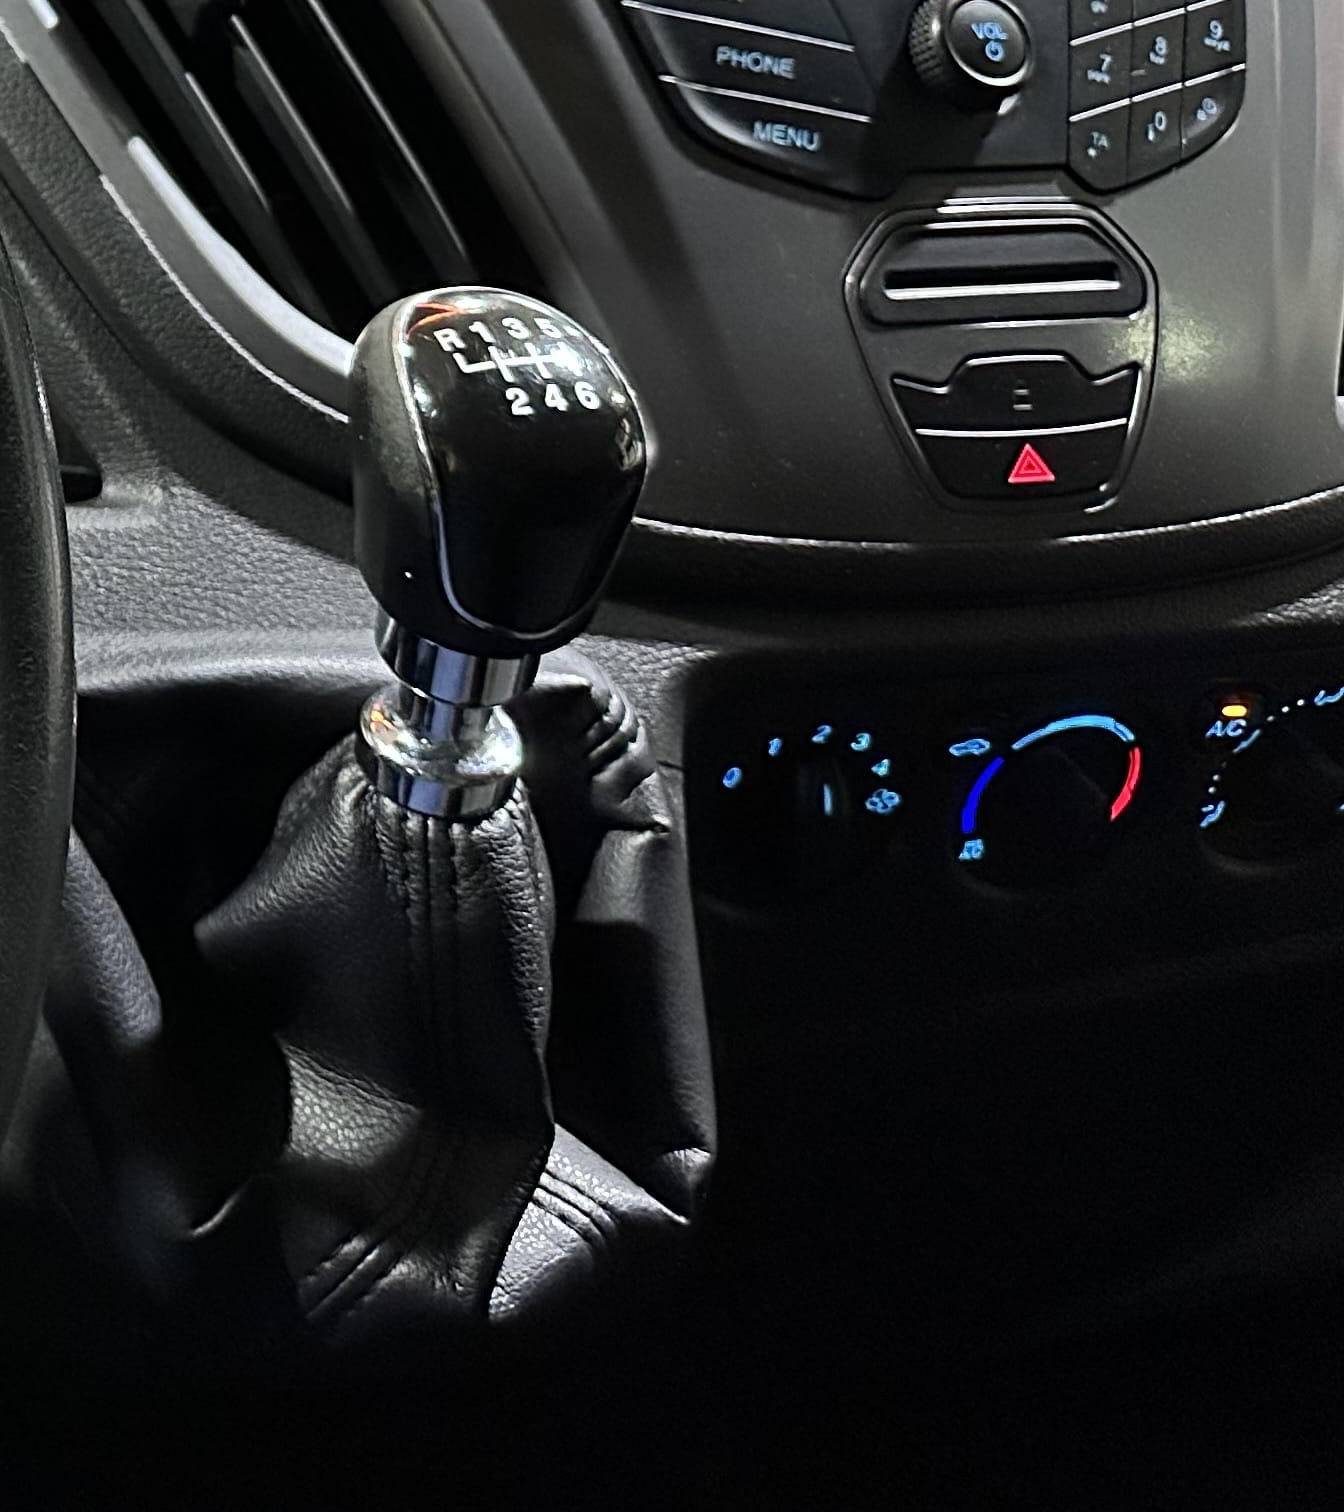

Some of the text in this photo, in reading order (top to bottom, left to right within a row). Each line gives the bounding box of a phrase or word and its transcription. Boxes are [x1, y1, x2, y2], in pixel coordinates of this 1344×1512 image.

[715, 45, 796, 80] PHONE
[753, 119, 821, 152] MENU
[433, 317, 561, 352] R 1 3 5
[505, 381, 600, 416] 2 4 6
[812, 724, 833, 744] 2
[850, 732, 872, 752] 3
